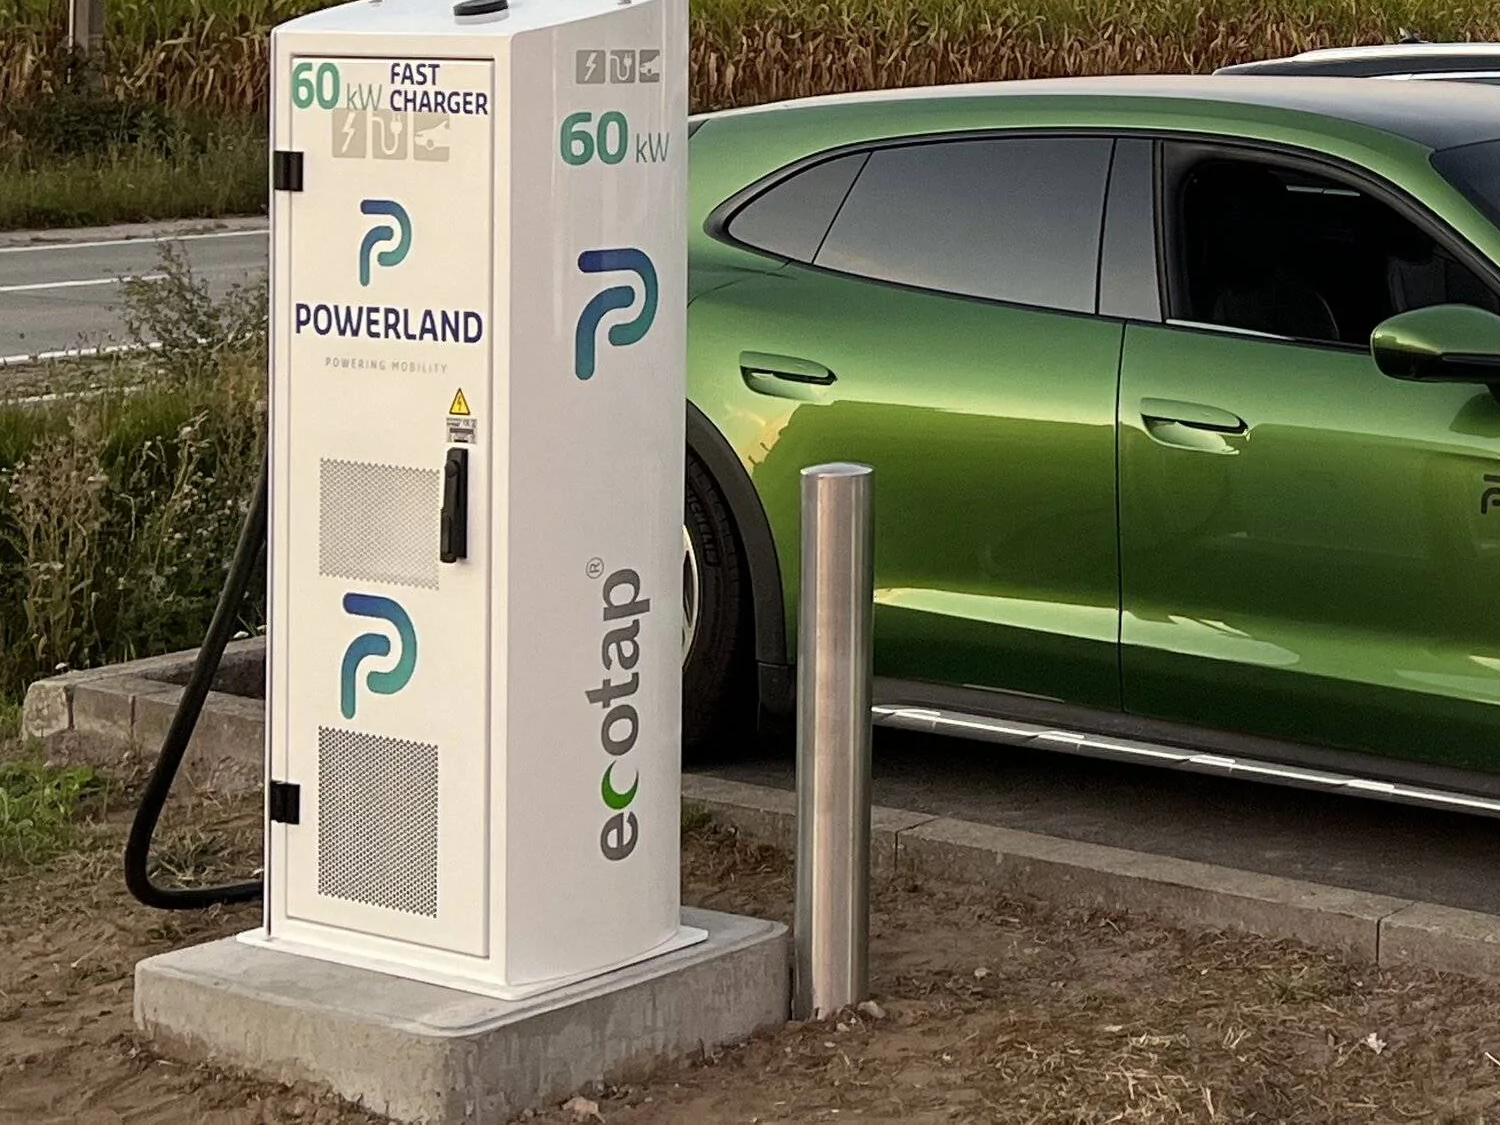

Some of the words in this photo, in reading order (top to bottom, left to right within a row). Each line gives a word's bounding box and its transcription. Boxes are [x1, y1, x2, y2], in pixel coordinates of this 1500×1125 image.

[292, 62, 341, 110] 60
[347, 83, 382, 111] kW
[390, 62, 440, 86] FAST
[390, 89, 488, 115] CHARGER
[561, 111, 628, 166] 60
[635, 132, 669, 164] kW
[295, 303, 484, 344] POWERLAND
[324, 356, 387, 371] POWERING
[392, 361, 449, 374] MOBILITY
